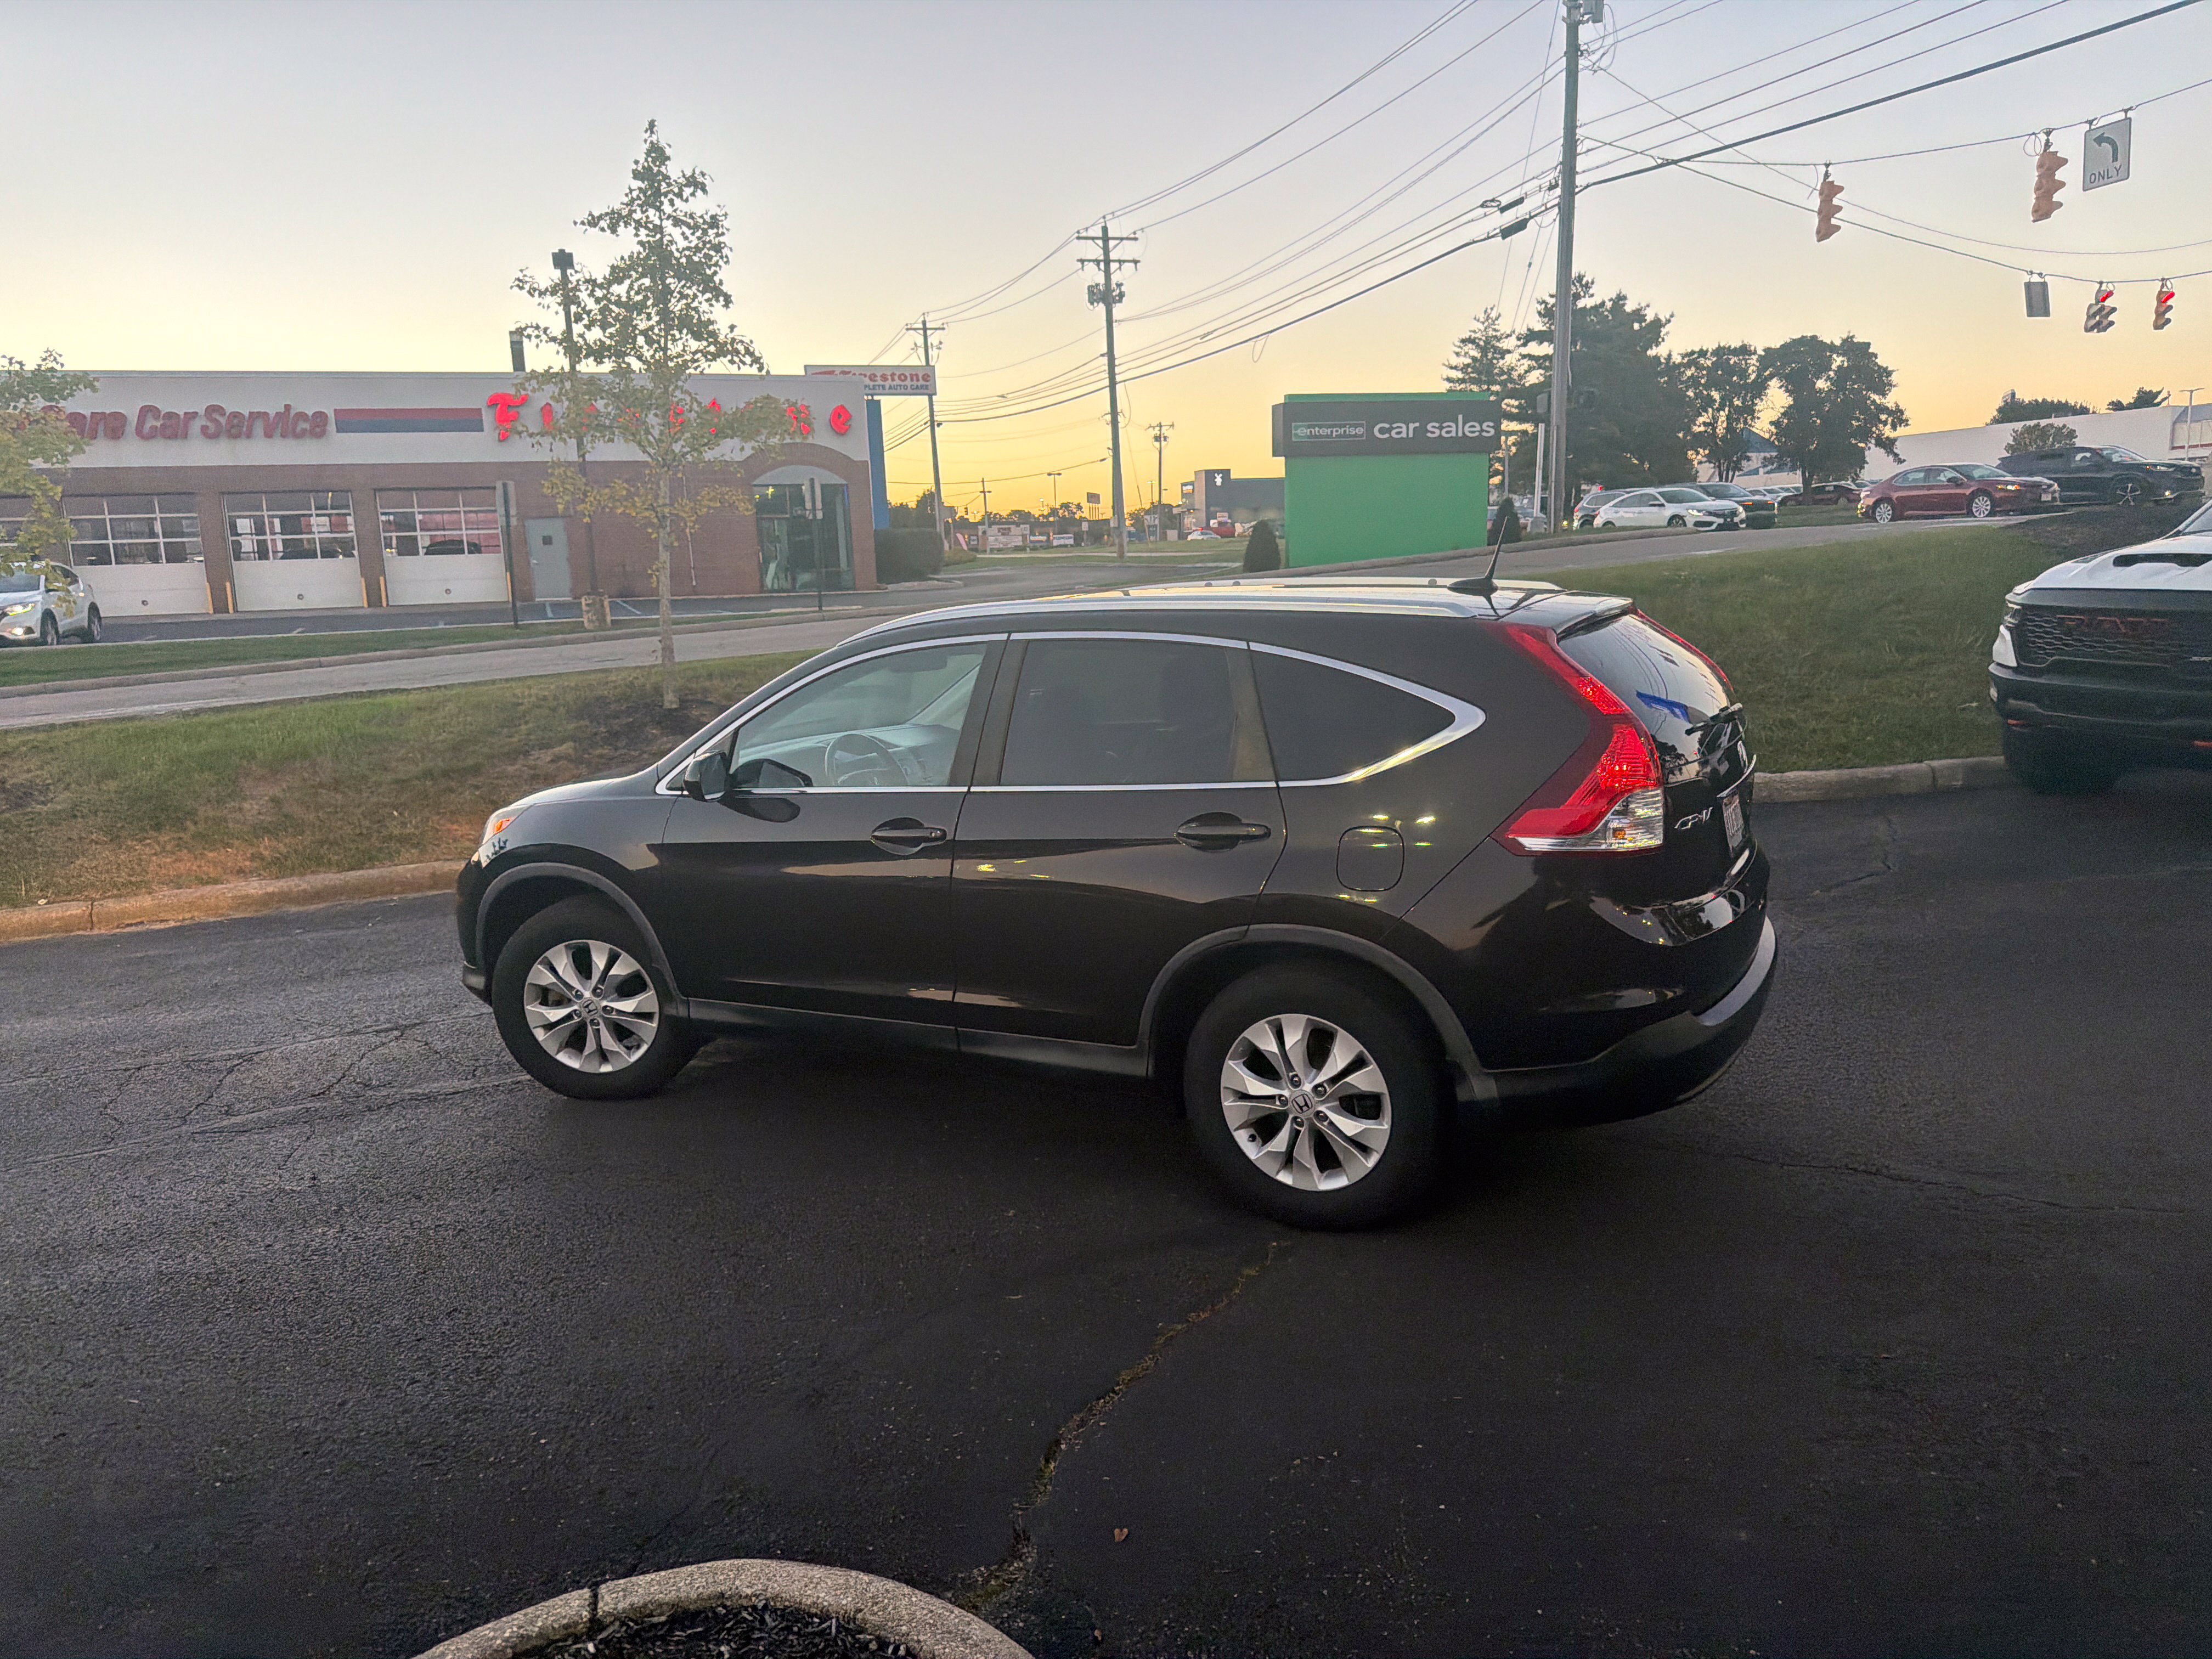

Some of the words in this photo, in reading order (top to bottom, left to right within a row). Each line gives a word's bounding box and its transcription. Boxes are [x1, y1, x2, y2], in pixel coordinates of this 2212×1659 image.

[2089, 164, 2122, 184] ONLY
[811, 370, 931, 383] estone
[41, 405, 127, 440] are
[135, 404, 199, 440] Car
[200, 404, 329, 439] Service
[1296, 424, 1365, 438] enterprise
[1373, 422, 1420, 439] car
[1426, 414, 1496, 438] sales
